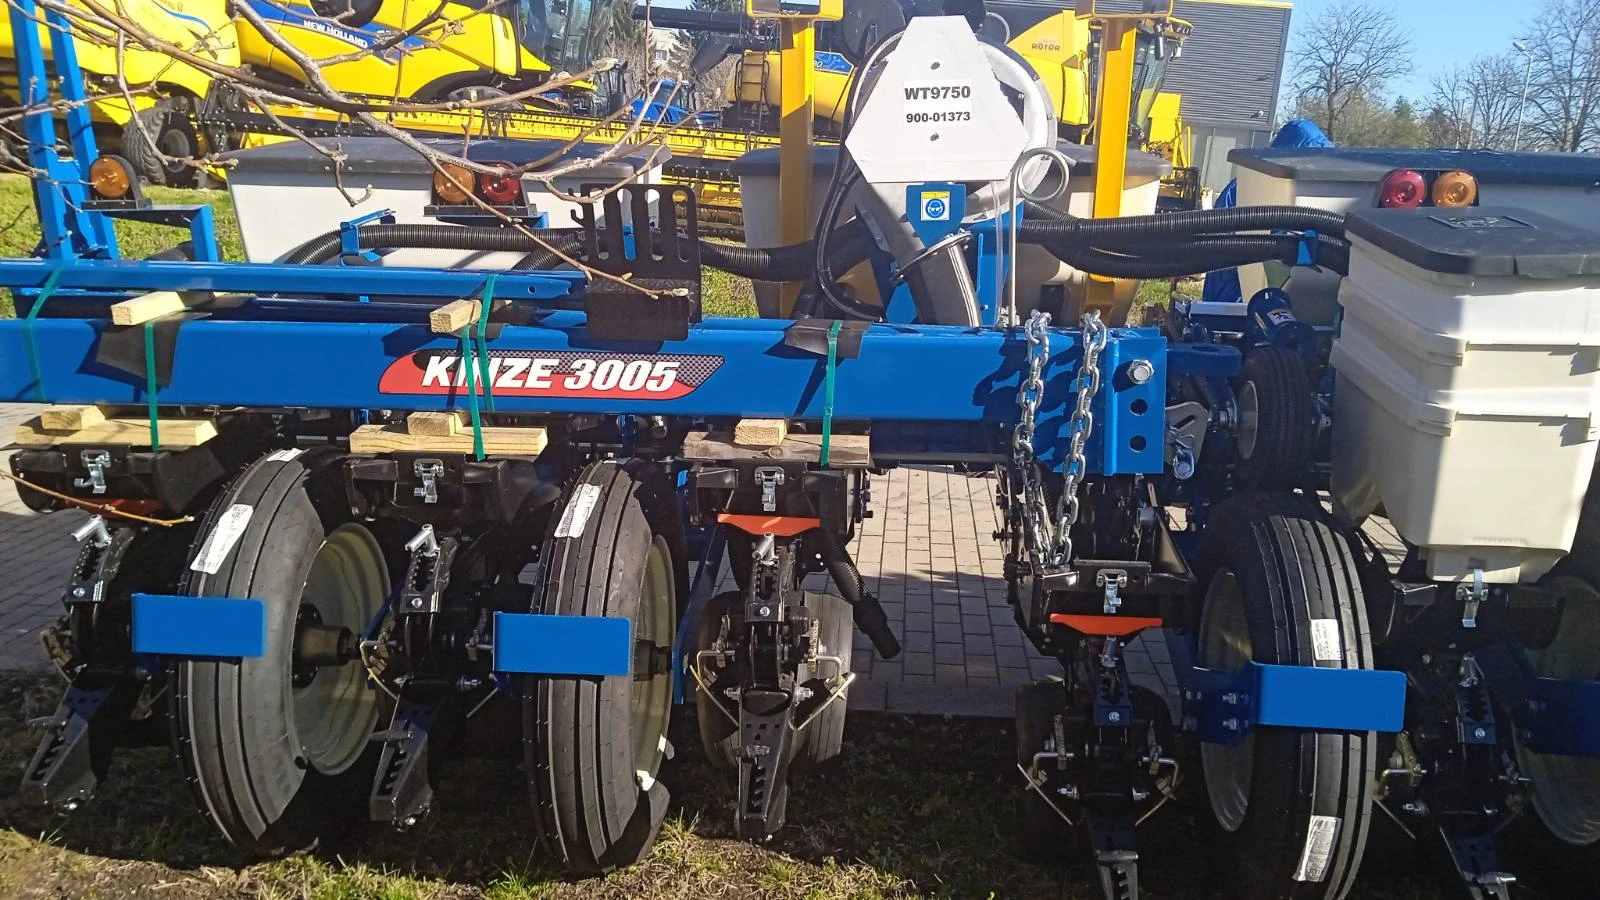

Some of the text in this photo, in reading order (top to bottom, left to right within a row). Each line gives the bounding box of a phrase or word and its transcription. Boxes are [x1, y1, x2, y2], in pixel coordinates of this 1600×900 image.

[303, 20, 368, 48] NEW HOLLAND
[1031, 42, 1061, 51] ROTOR
[904, 85, 971, 100] WT9750
[906, 111, 971, 123] 900-01373
[421, 355, 681, 392] KINZE 3005
